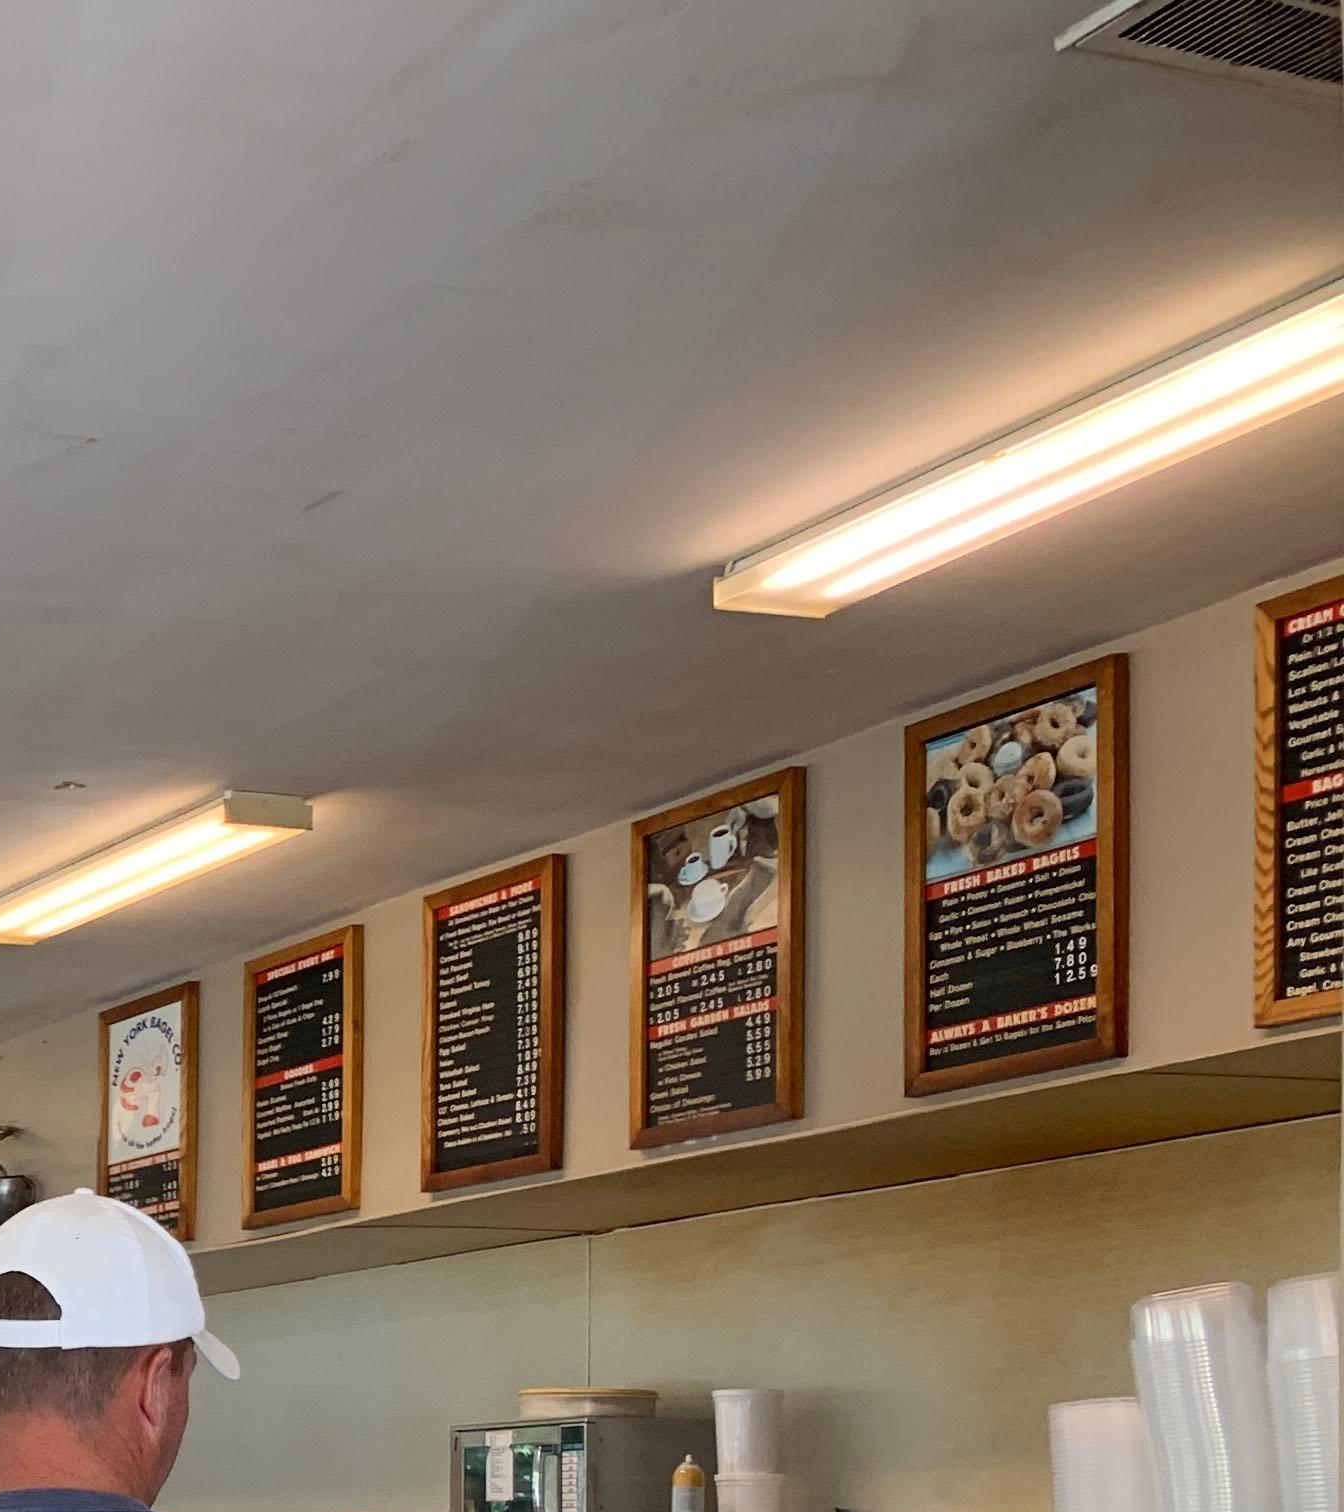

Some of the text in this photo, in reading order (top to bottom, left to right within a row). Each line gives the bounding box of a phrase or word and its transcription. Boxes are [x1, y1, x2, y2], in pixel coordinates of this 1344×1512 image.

[943, 847, 1079, 894] FRESH BAKED BAGELS
[123, 1018, 148, 1047] YORK
[149, 1016, 174, 1045] BAGEL
[931, 997, 1096, 1043] ALWAYS A BAKER'S DOZEN
